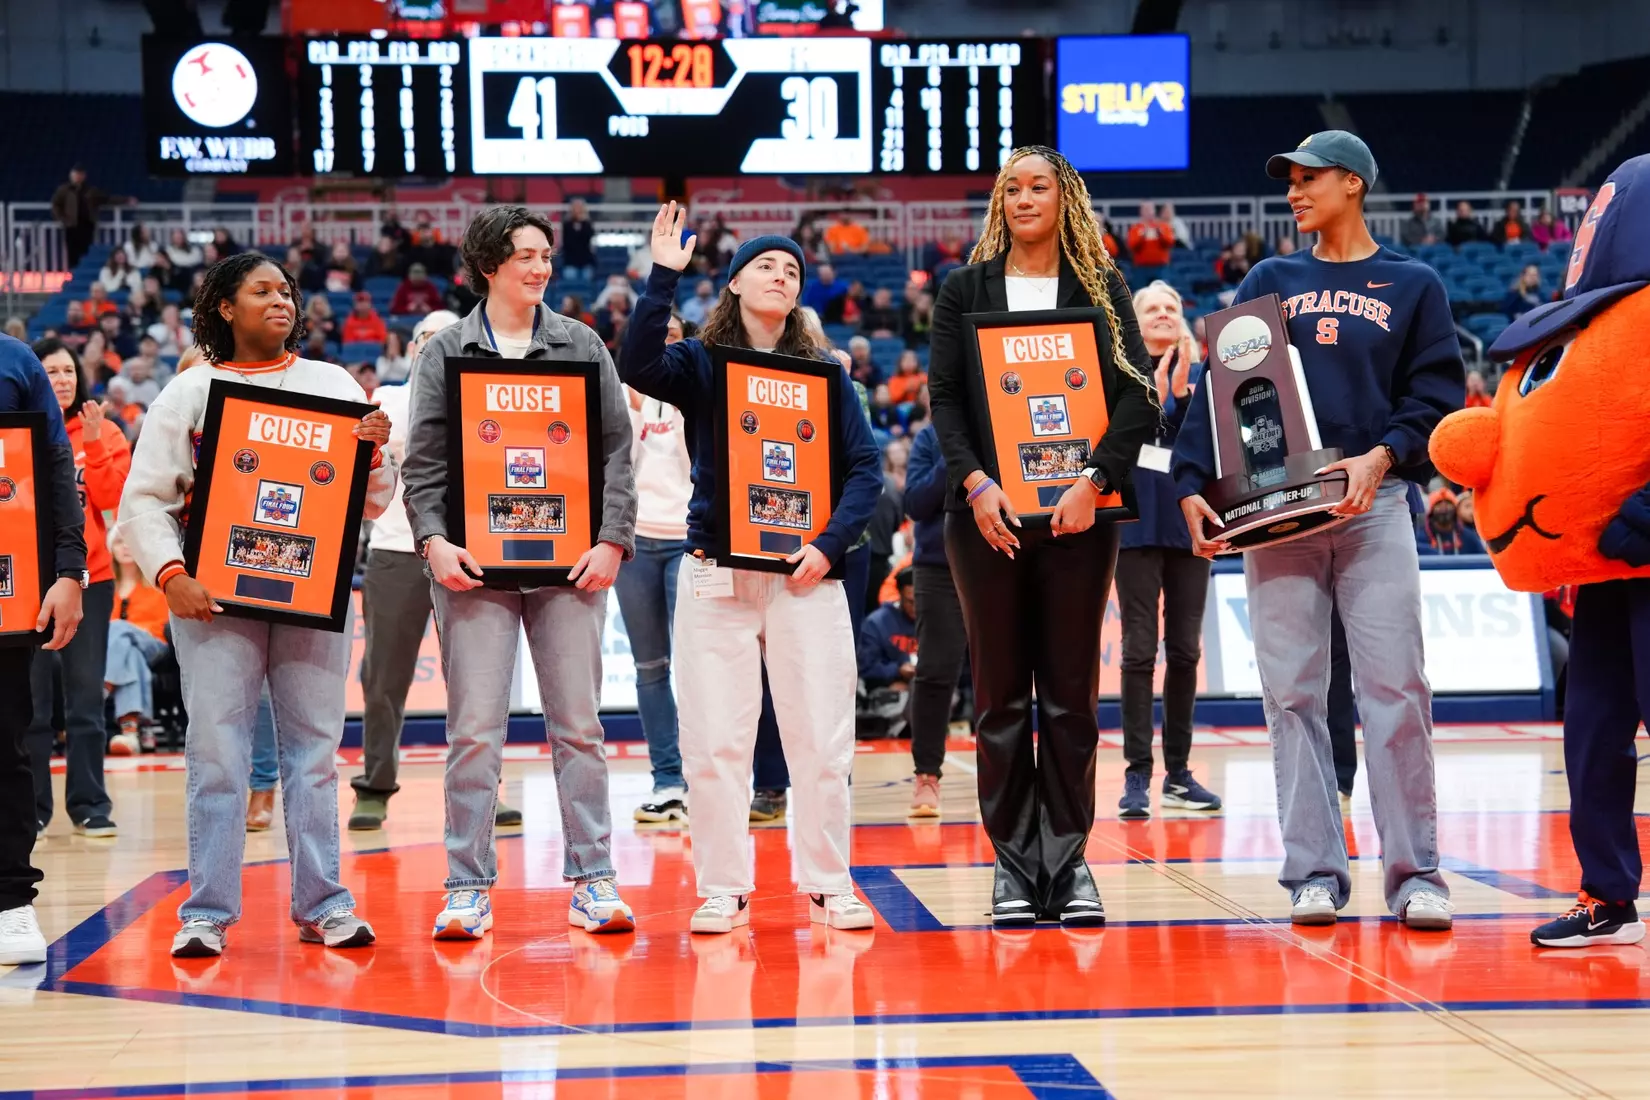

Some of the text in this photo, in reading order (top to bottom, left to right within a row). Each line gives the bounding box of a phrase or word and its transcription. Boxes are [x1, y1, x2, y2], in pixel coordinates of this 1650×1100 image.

[508, 76, 557, 140] 41
[780, 76, 838, 140] 30
[1316, 317, 1339, 345] S
[1005, 335, 1068, 361] 'CUSE
[1221, 334, 1272, 363] NCAA
[489, 386, 554, 412] 'CUSE
[749, 377, 804, 409] 'CUSE
[1240, 389, 1271, 407] DIVISION
[254, 415, 325, 450] 'CUSE
[1224, 487, 1313, 523] NATIONAL RUNNER-UP
